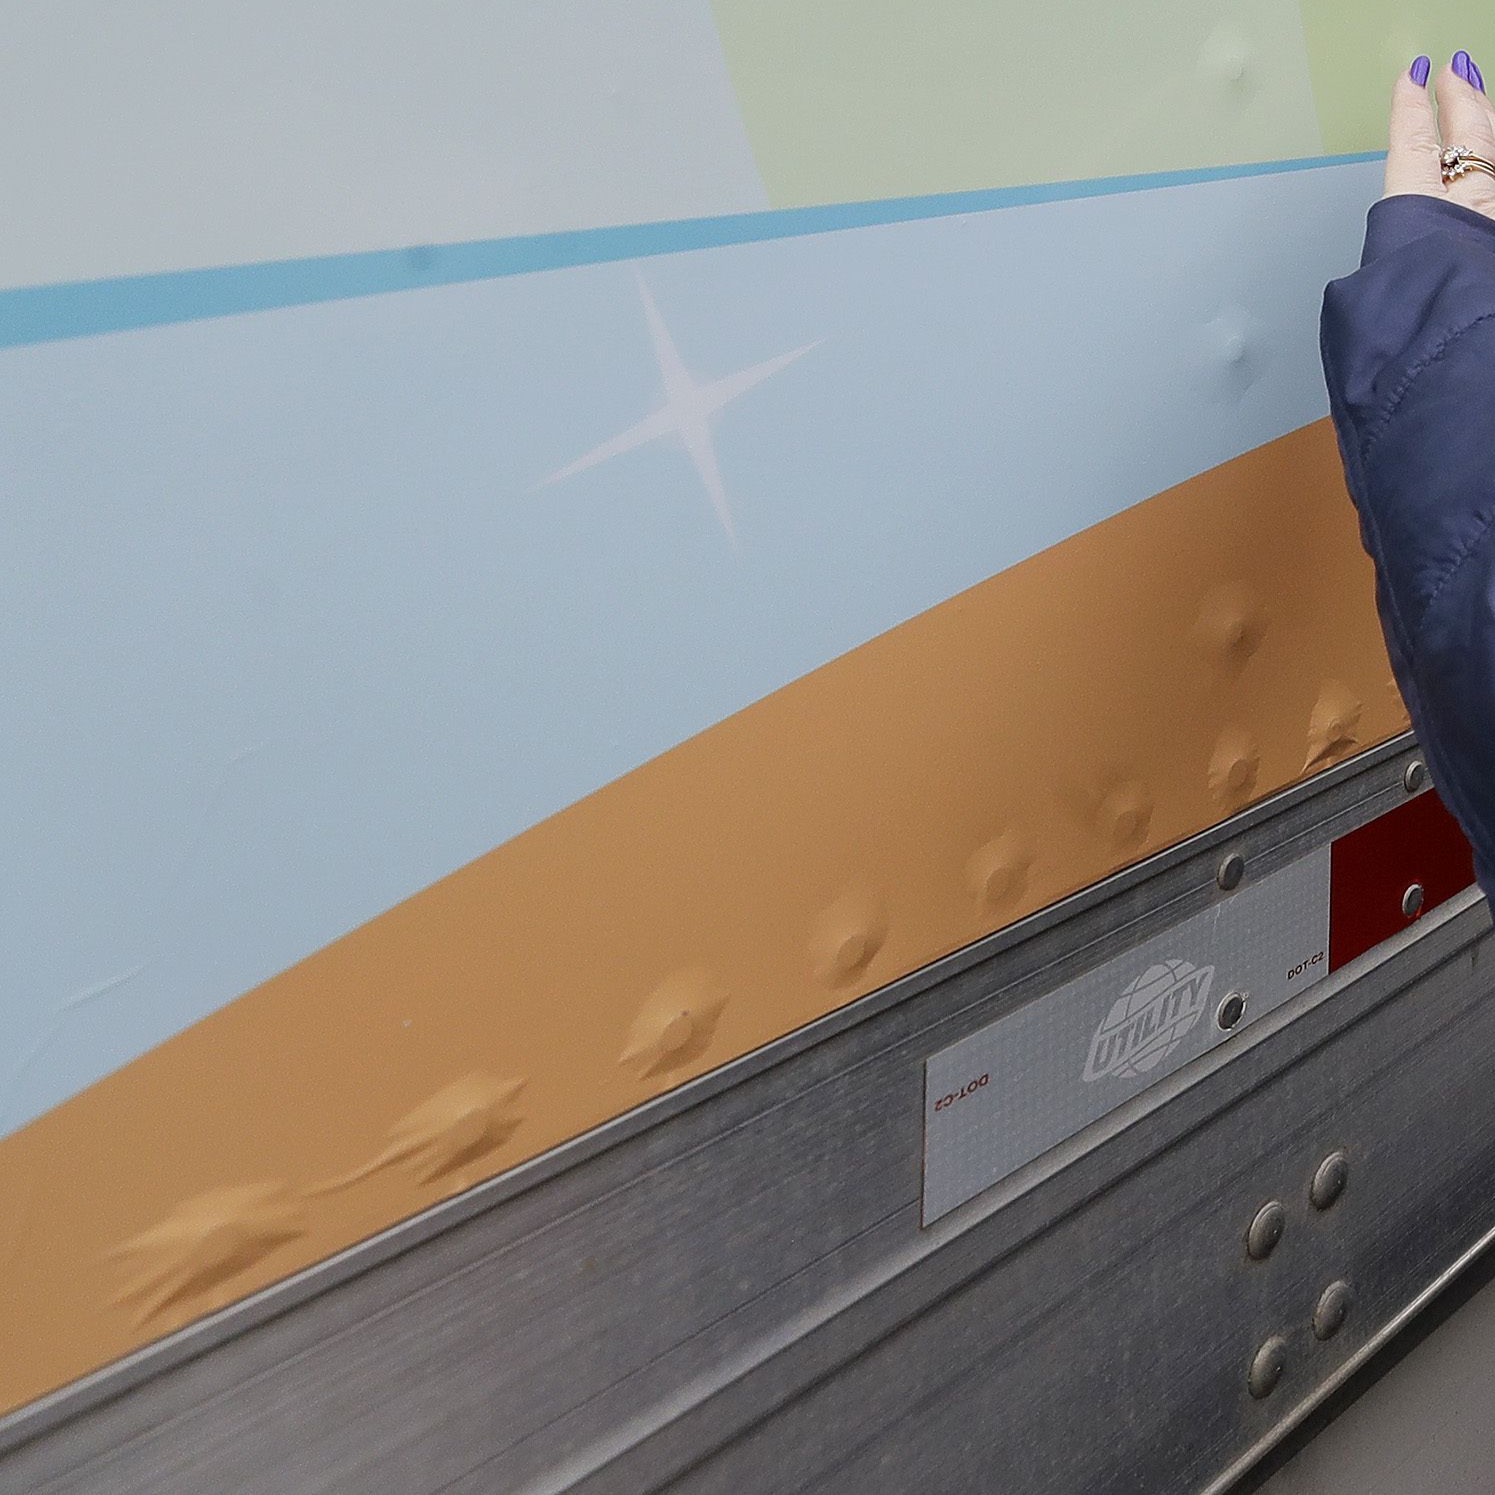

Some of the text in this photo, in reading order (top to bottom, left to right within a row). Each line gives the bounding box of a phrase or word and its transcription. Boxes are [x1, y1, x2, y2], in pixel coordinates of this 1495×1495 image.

[1287, 951, 1325, 981] DOT-C2
[1092, 971, 1209, 1074] UTILITY
[934, 1073, 989, 1112] DOT-C2
